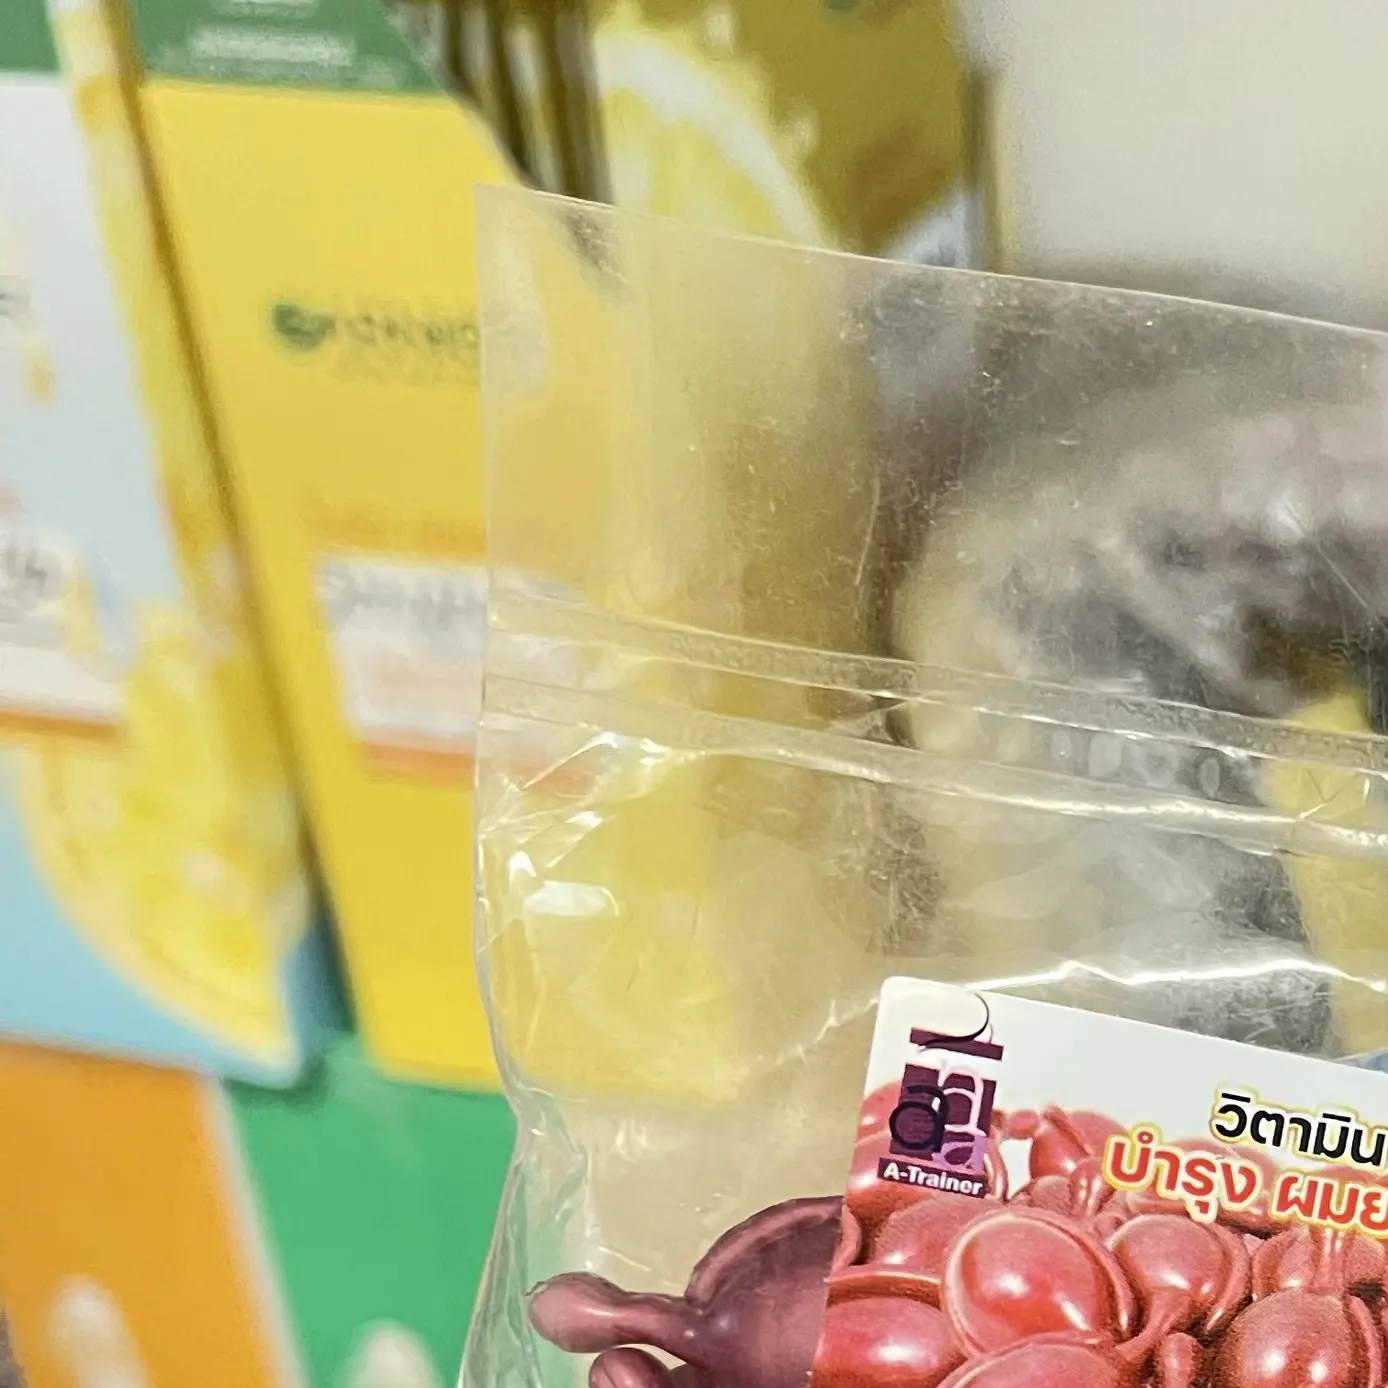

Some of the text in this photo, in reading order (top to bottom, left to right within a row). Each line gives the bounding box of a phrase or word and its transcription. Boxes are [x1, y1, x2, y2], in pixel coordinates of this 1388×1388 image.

[1215, 1092, 1387, 1166] วิตามิน
[883, 1162, 983, 1196] A-Trainer
[1110, 1131, 1258, 1213] บำรุง
